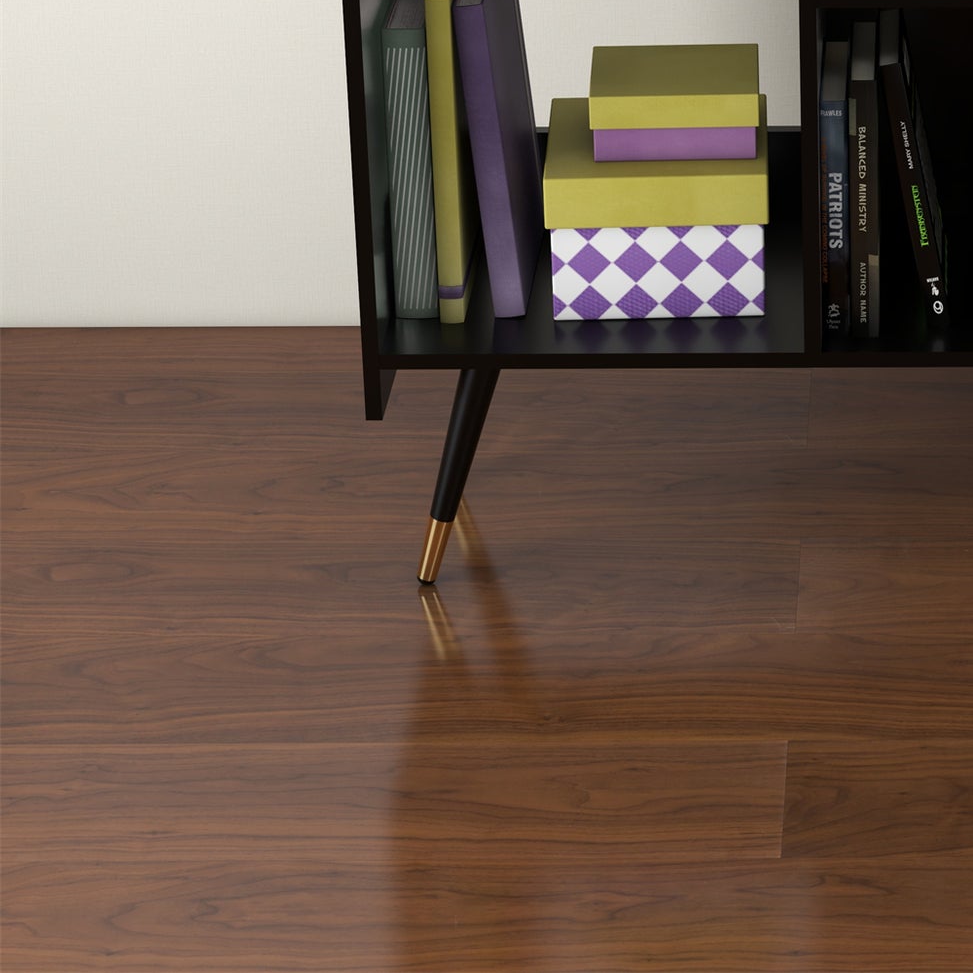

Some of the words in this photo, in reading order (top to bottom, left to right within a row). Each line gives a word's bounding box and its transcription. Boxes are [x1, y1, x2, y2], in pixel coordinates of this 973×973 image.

[858, 126, 867, 179] BALANCED
[900, 120, 910, 148] SHELLY
[905, 148, 914, 170] MARY
[828, 172, 843, 249] PATRIOTS
[858, 183, 867, 233] MINISTRY
[859, 299, 867, 324] NAME
